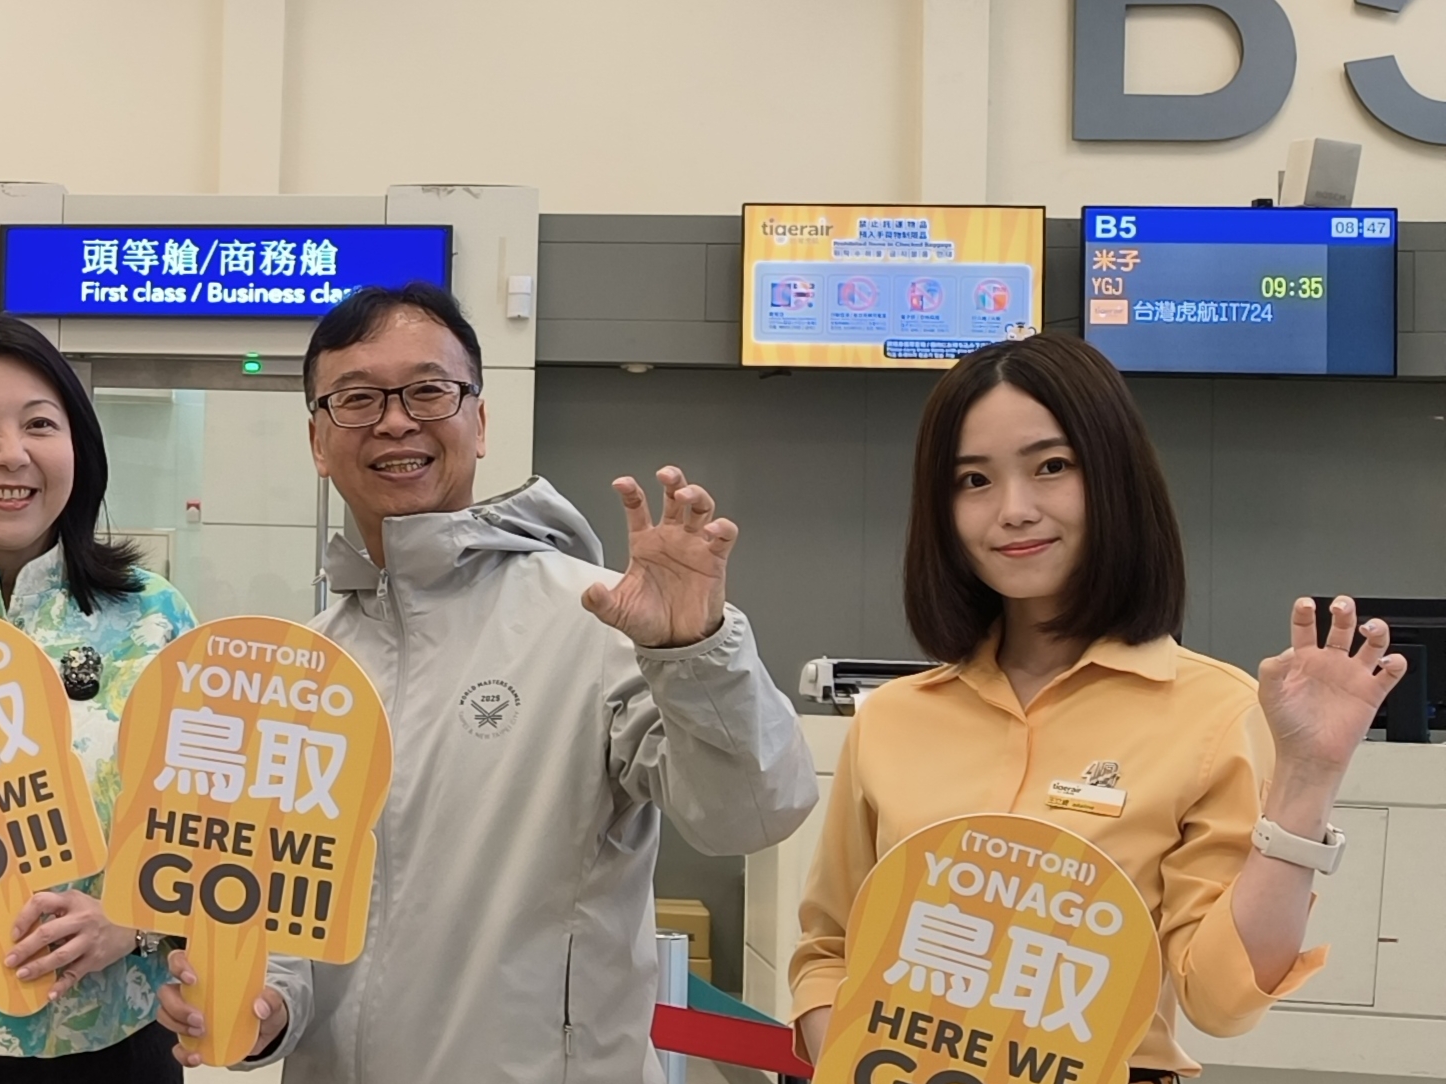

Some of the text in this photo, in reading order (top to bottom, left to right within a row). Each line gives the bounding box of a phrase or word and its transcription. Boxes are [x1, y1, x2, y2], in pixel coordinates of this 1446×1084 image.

[761, 218, 834, 240] tigerair
[1095, 216, 1137, 238] B5
[1333, 220, 1388, 235] 08:47
[81, 238, 339, 276] 頭等艙/商務艙
[1092, 249, 1141, 272] 米子
[81, 281, 361, 306] First class / Business cla
[1092, 277, 1123, 295] YGJ
[1261, 276, 1323, 298] 09:35
[1133, 301, 1273, 323] 台灣虎航IT724
[207, 635, 326, 672] (TOTTORI)
[176, 661, 353, 717] YONAGO
[459, 679, 521, 707] WORLD MASTERS GAMES
[153, 706, 347, 820] 鳥取
[145, 807, 336, 871] HERE WE
[961, 830, 1096, 886] (TOTTORI)
[138, 852, 332, 940] GO!!!
[924, 852, 1123, 936] YONAGO
[883, 900, 1110, 1043] 鳥取
[867, 1000, 994, 1068] HERE
